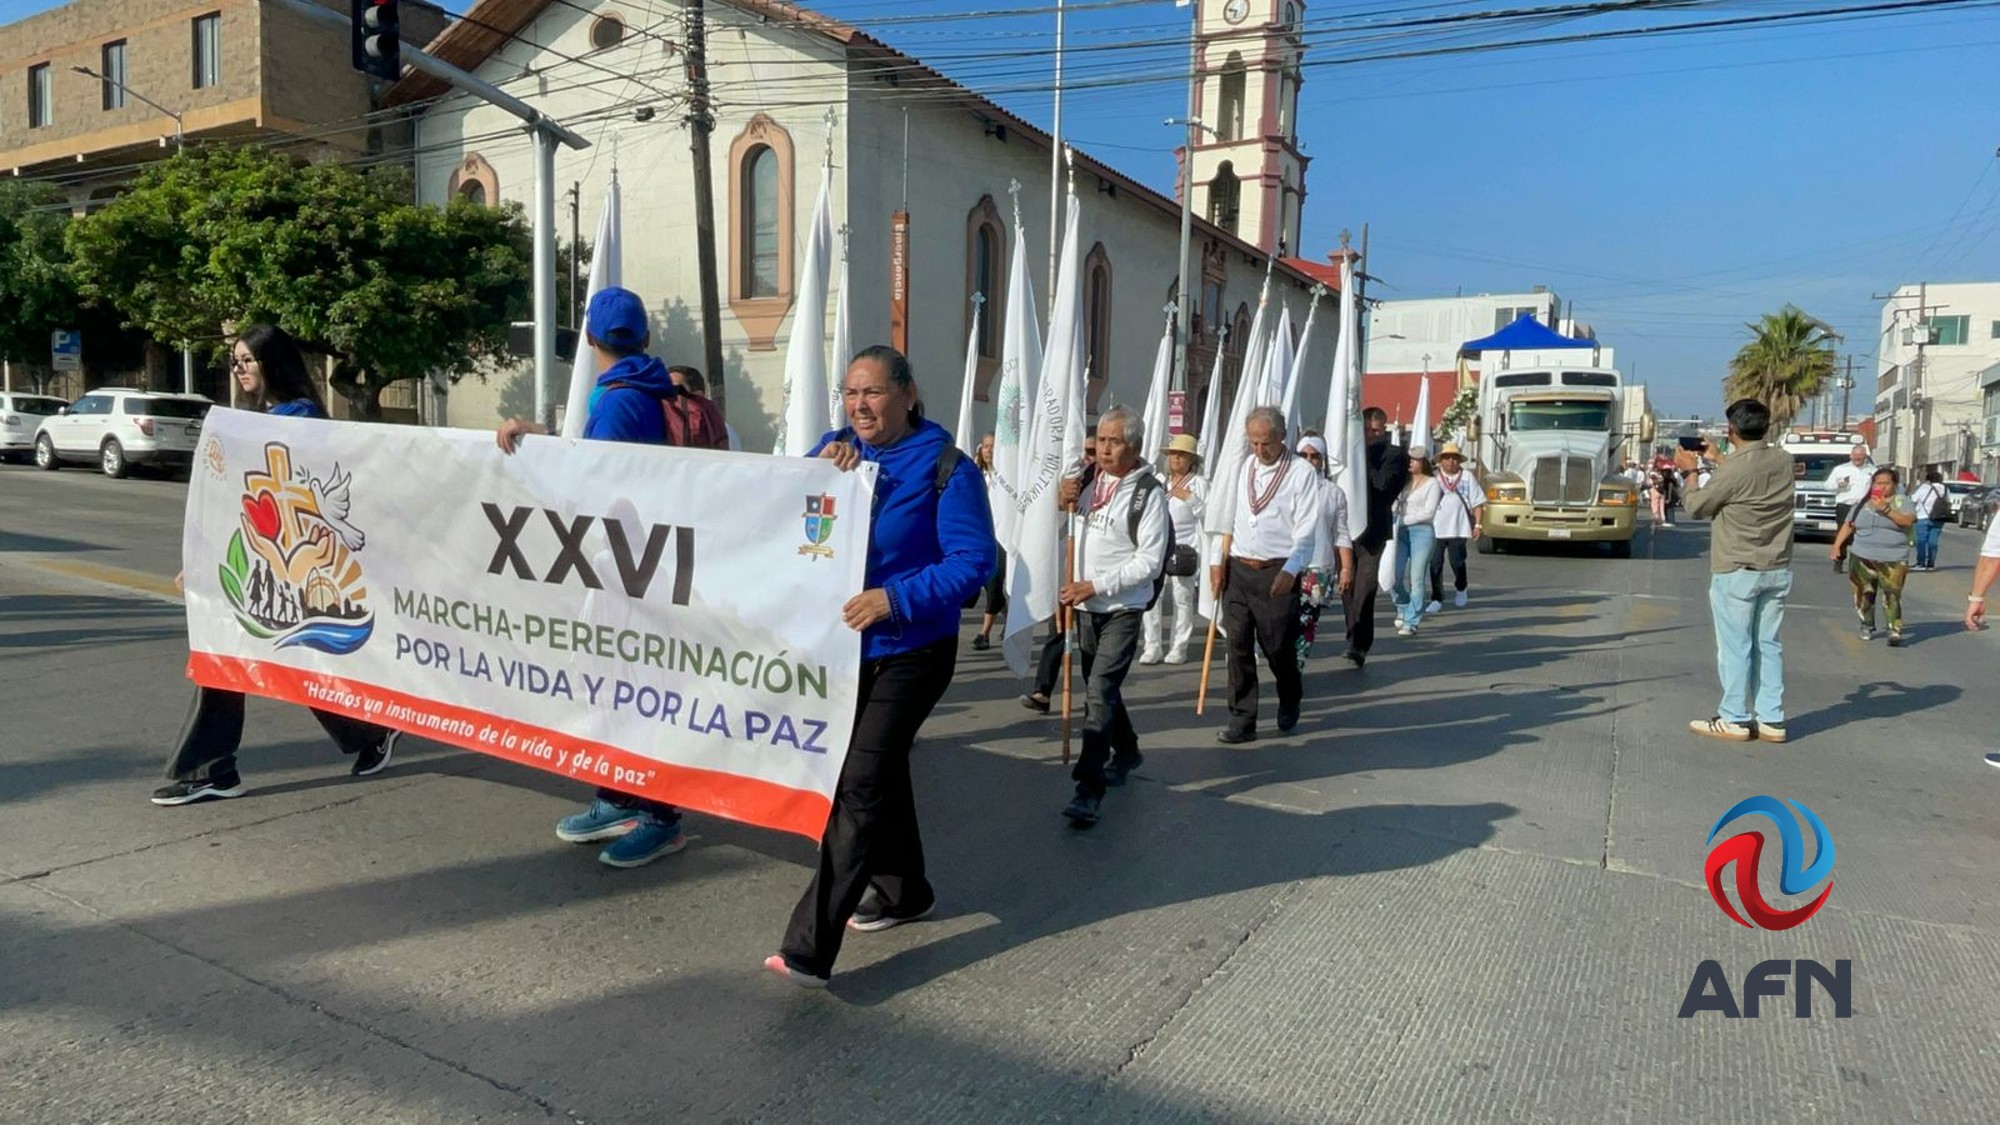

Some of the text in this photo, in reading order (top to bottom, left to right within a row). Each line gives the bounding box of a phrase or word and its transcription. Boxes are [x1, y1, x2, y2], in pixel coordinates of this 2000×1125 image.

[893, 223, 904, 300] Emergencia
[481, 502, 695, 606] XXVI
[394, 586, 828, 699] MARCHA-PEREGRINACIÓN
[396, 633, 828, 754] POR LA VIDA Y POR LA PAZ
[303, 680, 656, 787] "Haznos un instrumento de la vida y de la paz"
